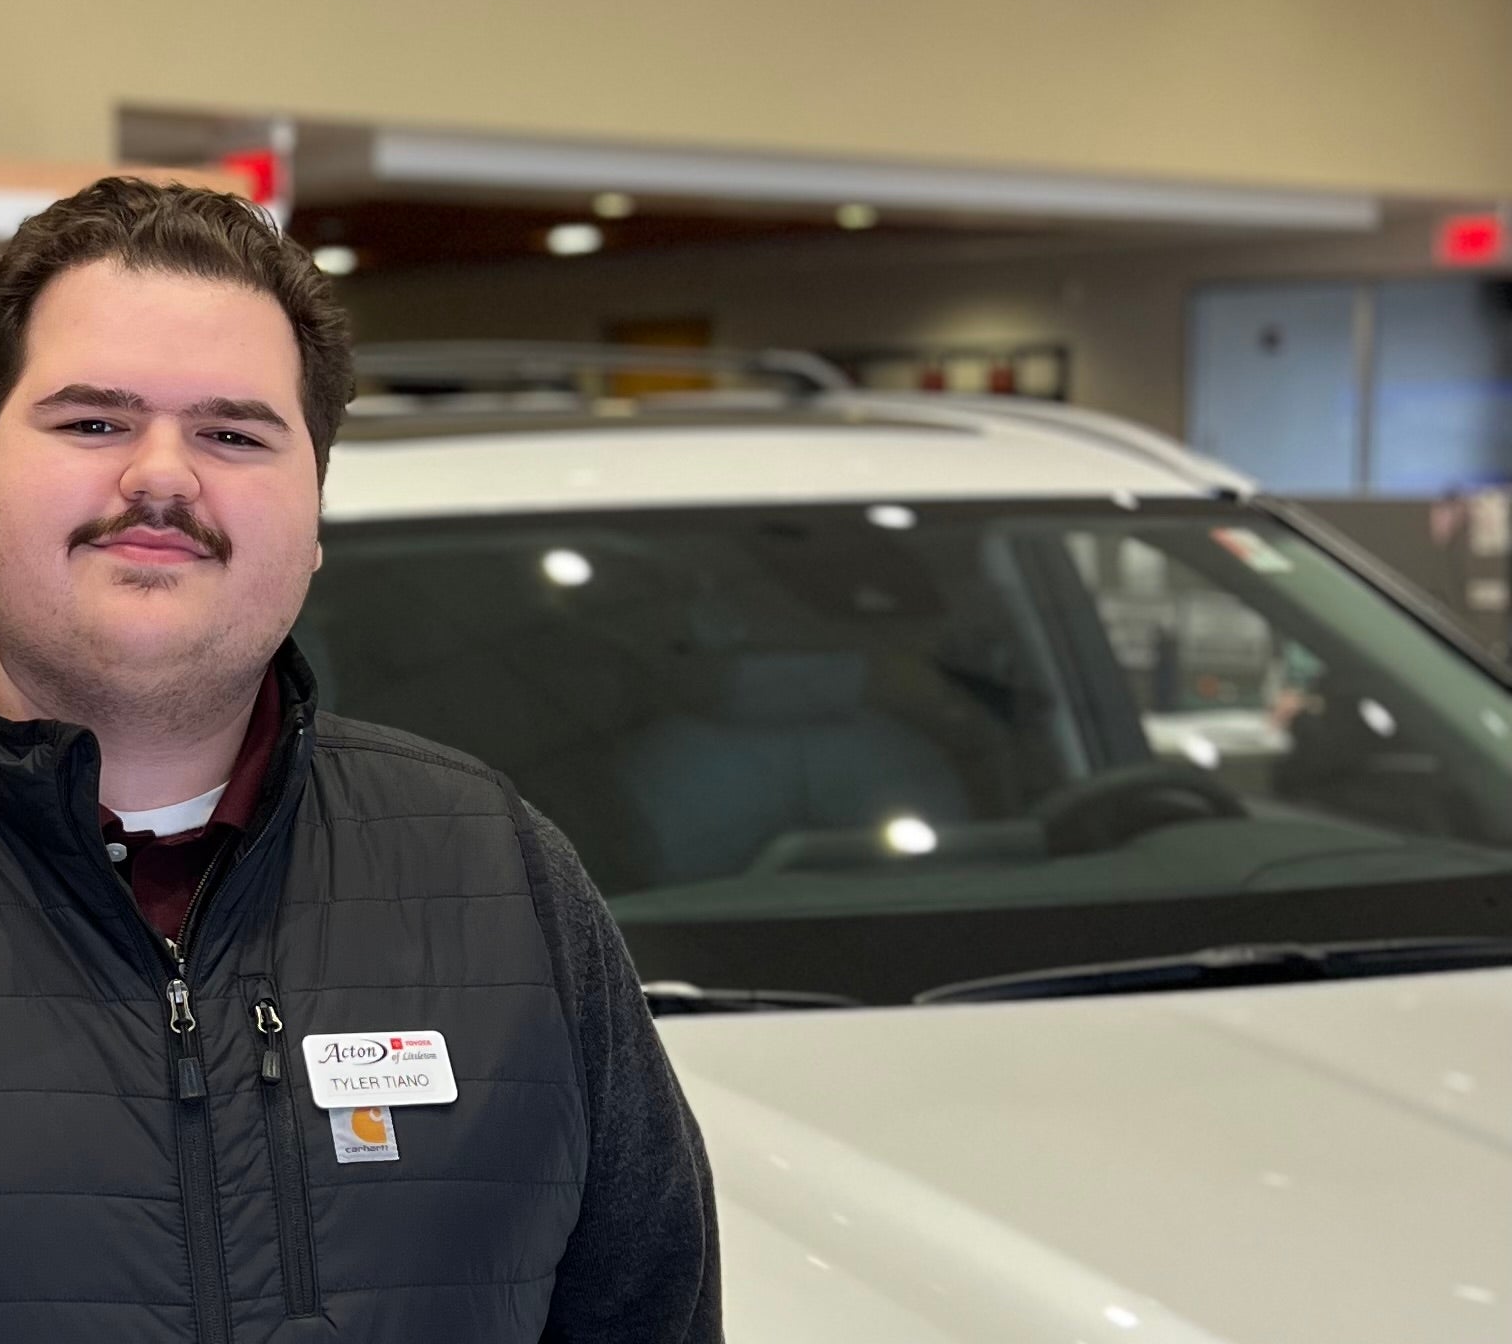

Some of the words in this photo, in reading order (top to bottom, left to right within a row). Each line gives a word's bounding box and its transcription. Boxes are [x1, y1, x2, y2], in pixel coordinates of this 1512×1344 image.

[318, 1043, 377, 1064] Acton
[392, 1052, 400, 1064] of
[330, 1076, 380, 1091] TYLER
[383, 1073, 429, 1088] TIANO
[345, 1145, 389, 1154] carhartt
